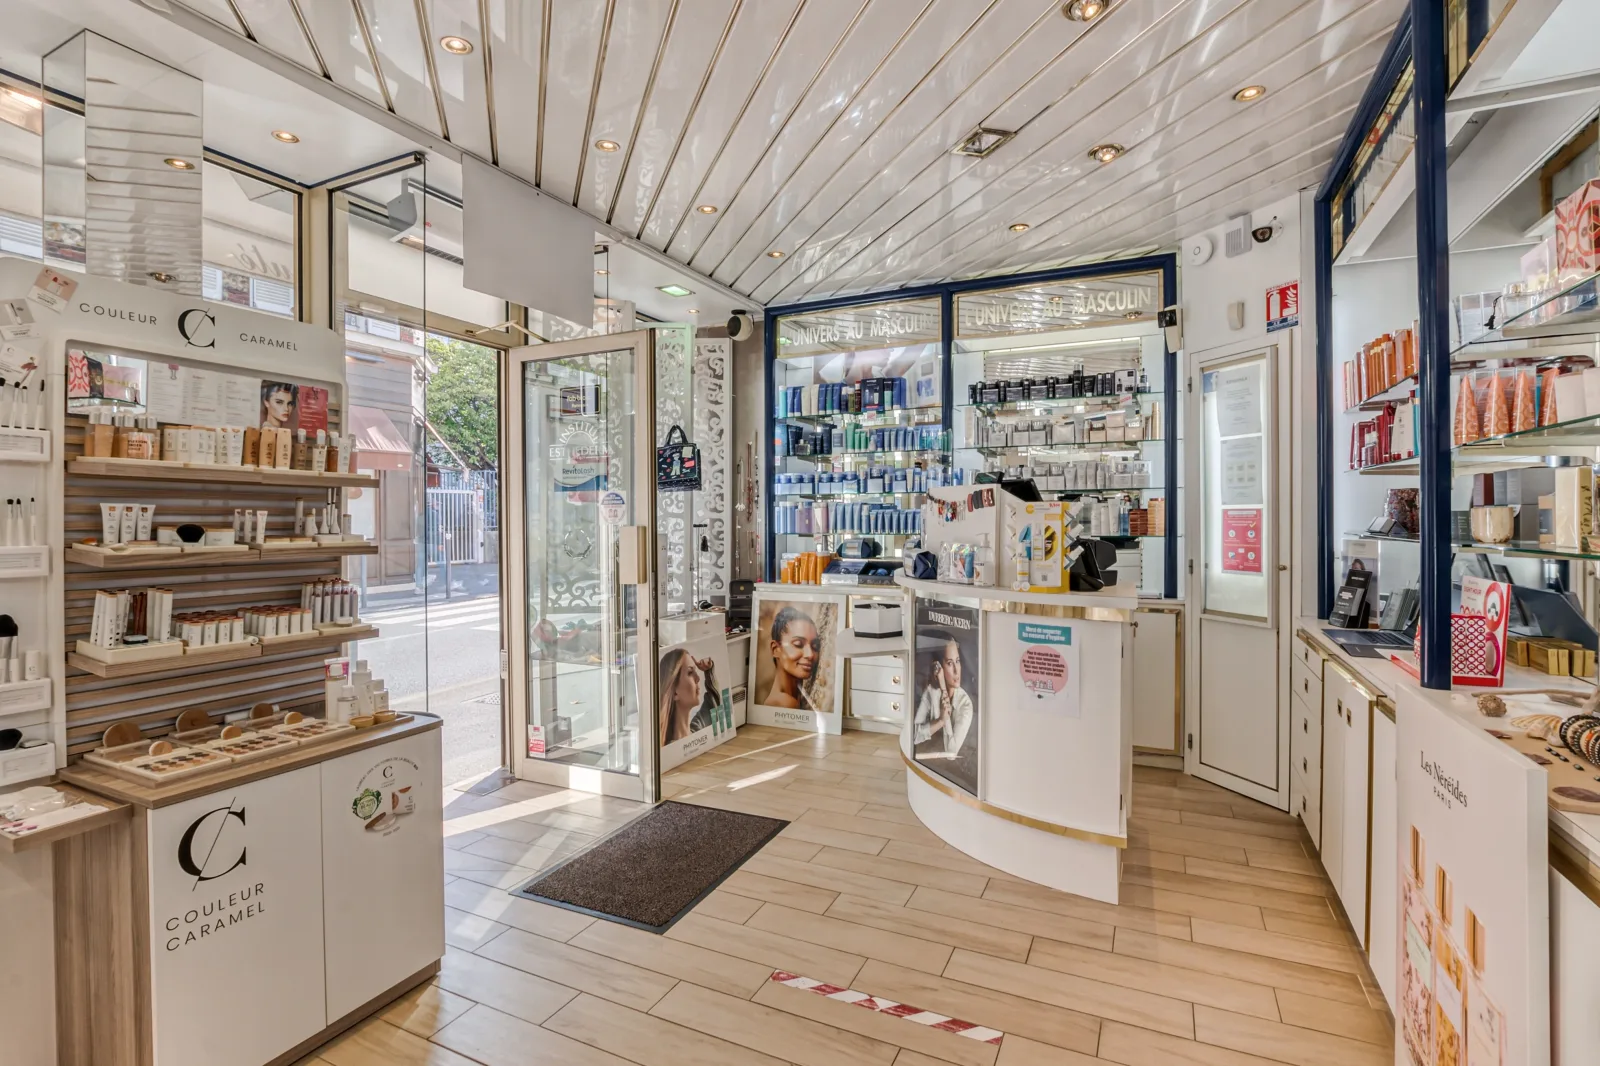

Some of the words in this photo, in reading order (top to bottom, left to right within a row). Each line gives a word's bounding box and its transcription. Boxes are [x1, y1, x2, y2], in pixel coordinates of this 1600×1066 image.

[1072, 287, 1150, 316] MASCULIN
[79, 302, 158, 326] COULEUR
[239, 332, 299, 352] CARAMEL
[846, 319, 864, 340] AU
[774, 711, 810, 724] PHYTOMER
[683, 734, 709, 750] PHYTOMER
[1421, 750, 1432, 776] Les
[1433, 761, 1468, 808] Néréides
[1433, 785, 1451, 809] PARIS
[165, 882, 265, 931] COULEUR
[166, 901, 265, 951] CARAMEL
